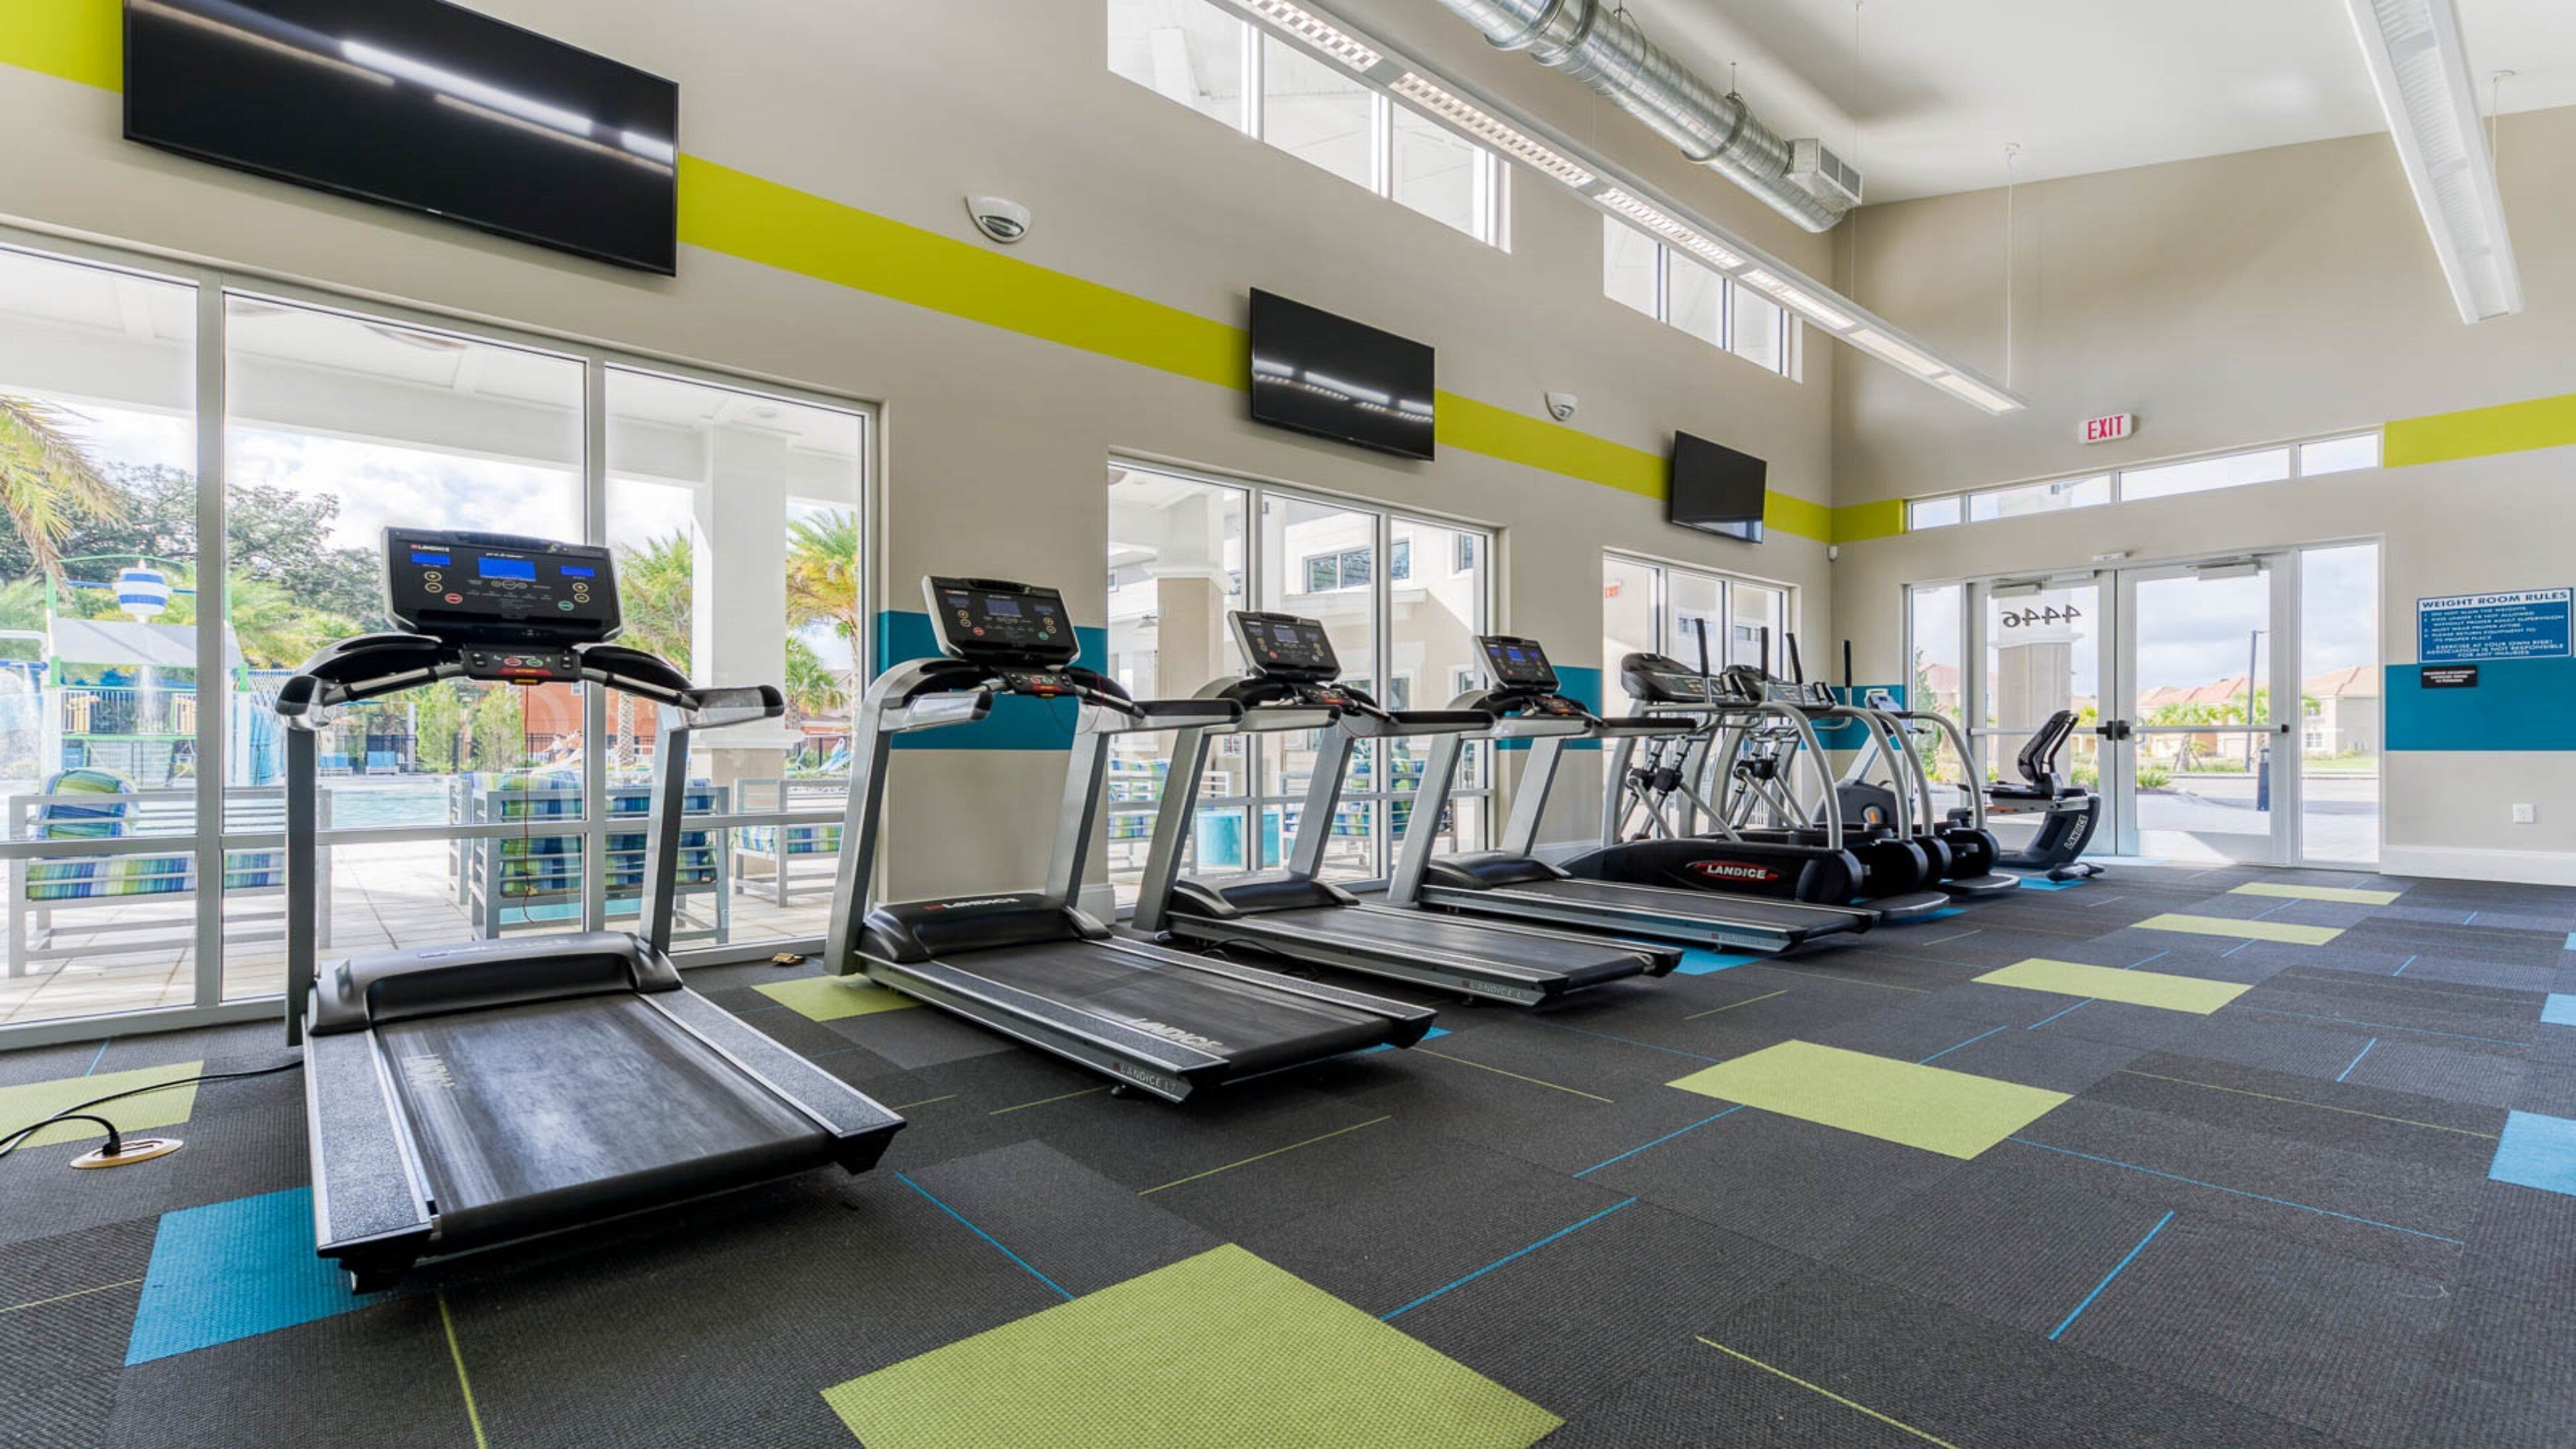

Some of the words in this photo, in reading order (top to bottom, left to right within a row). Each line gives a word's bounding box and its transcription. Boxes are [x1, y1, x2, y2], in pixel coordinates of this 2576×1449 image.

[2088, 415, 2124, 440] EXIT
[2422, 599, 2473, 608] WEIGHT
[2477, 594, 2520, 604] ROOM
[2526, 592, 2567, 602] RULES
[1707, 864, 1766, 879] LANDICE
[1120, 1064, 1161, 1087] LANDICE
